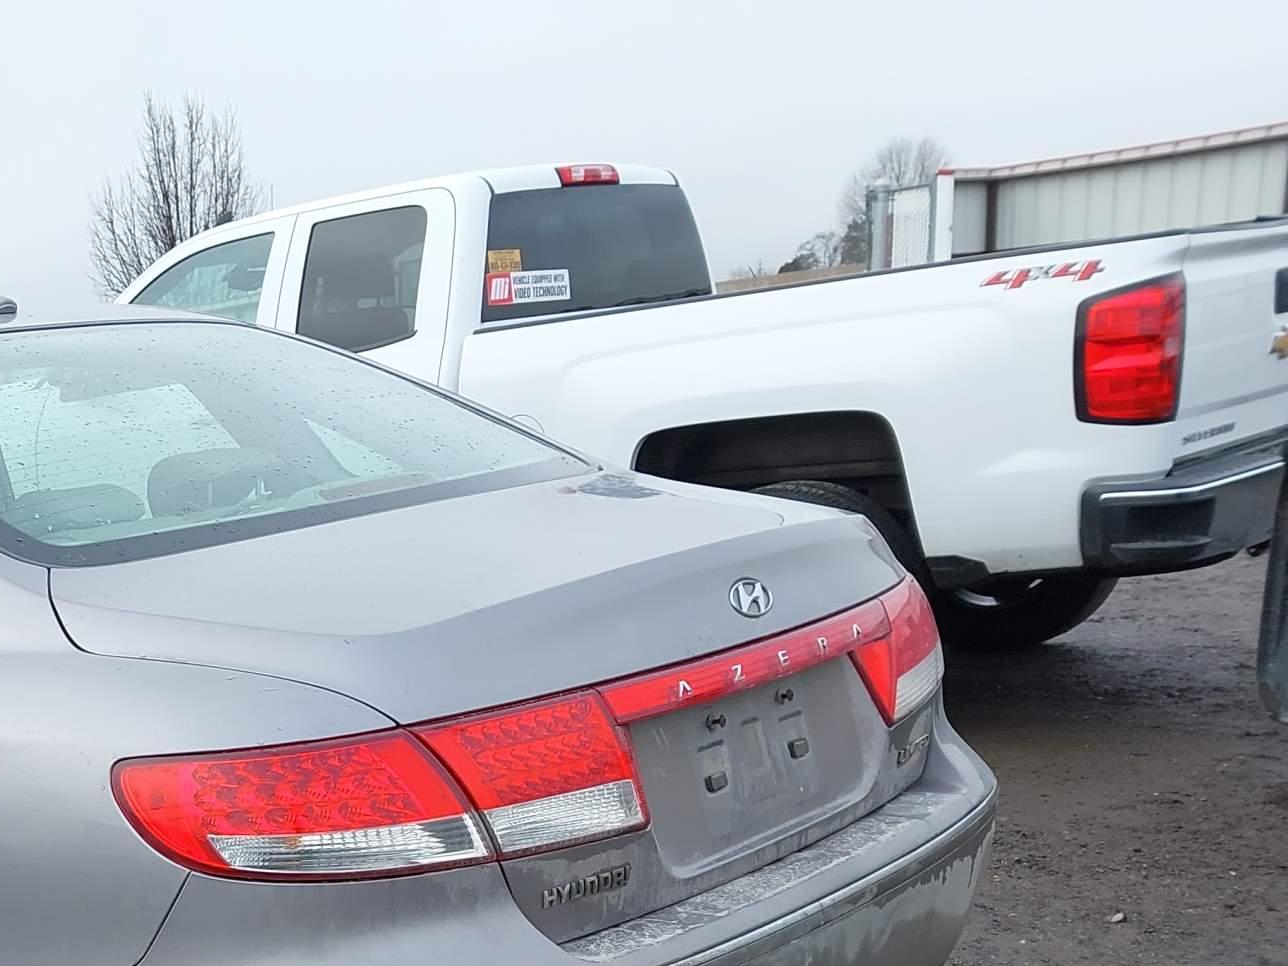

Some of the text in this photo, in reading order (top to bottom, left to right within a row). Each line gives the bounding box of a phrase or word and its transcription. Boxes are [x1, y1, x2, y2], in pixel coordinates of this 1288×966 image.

[512, 273, 565, 285] VEHICLE EQUIPPED WITH
[513, 284, 568, 299] VIDEO TECHNOLOGY
[678, 623, 862, 698] AZERA
[541, 863, 632, 909] HYUNDAI
